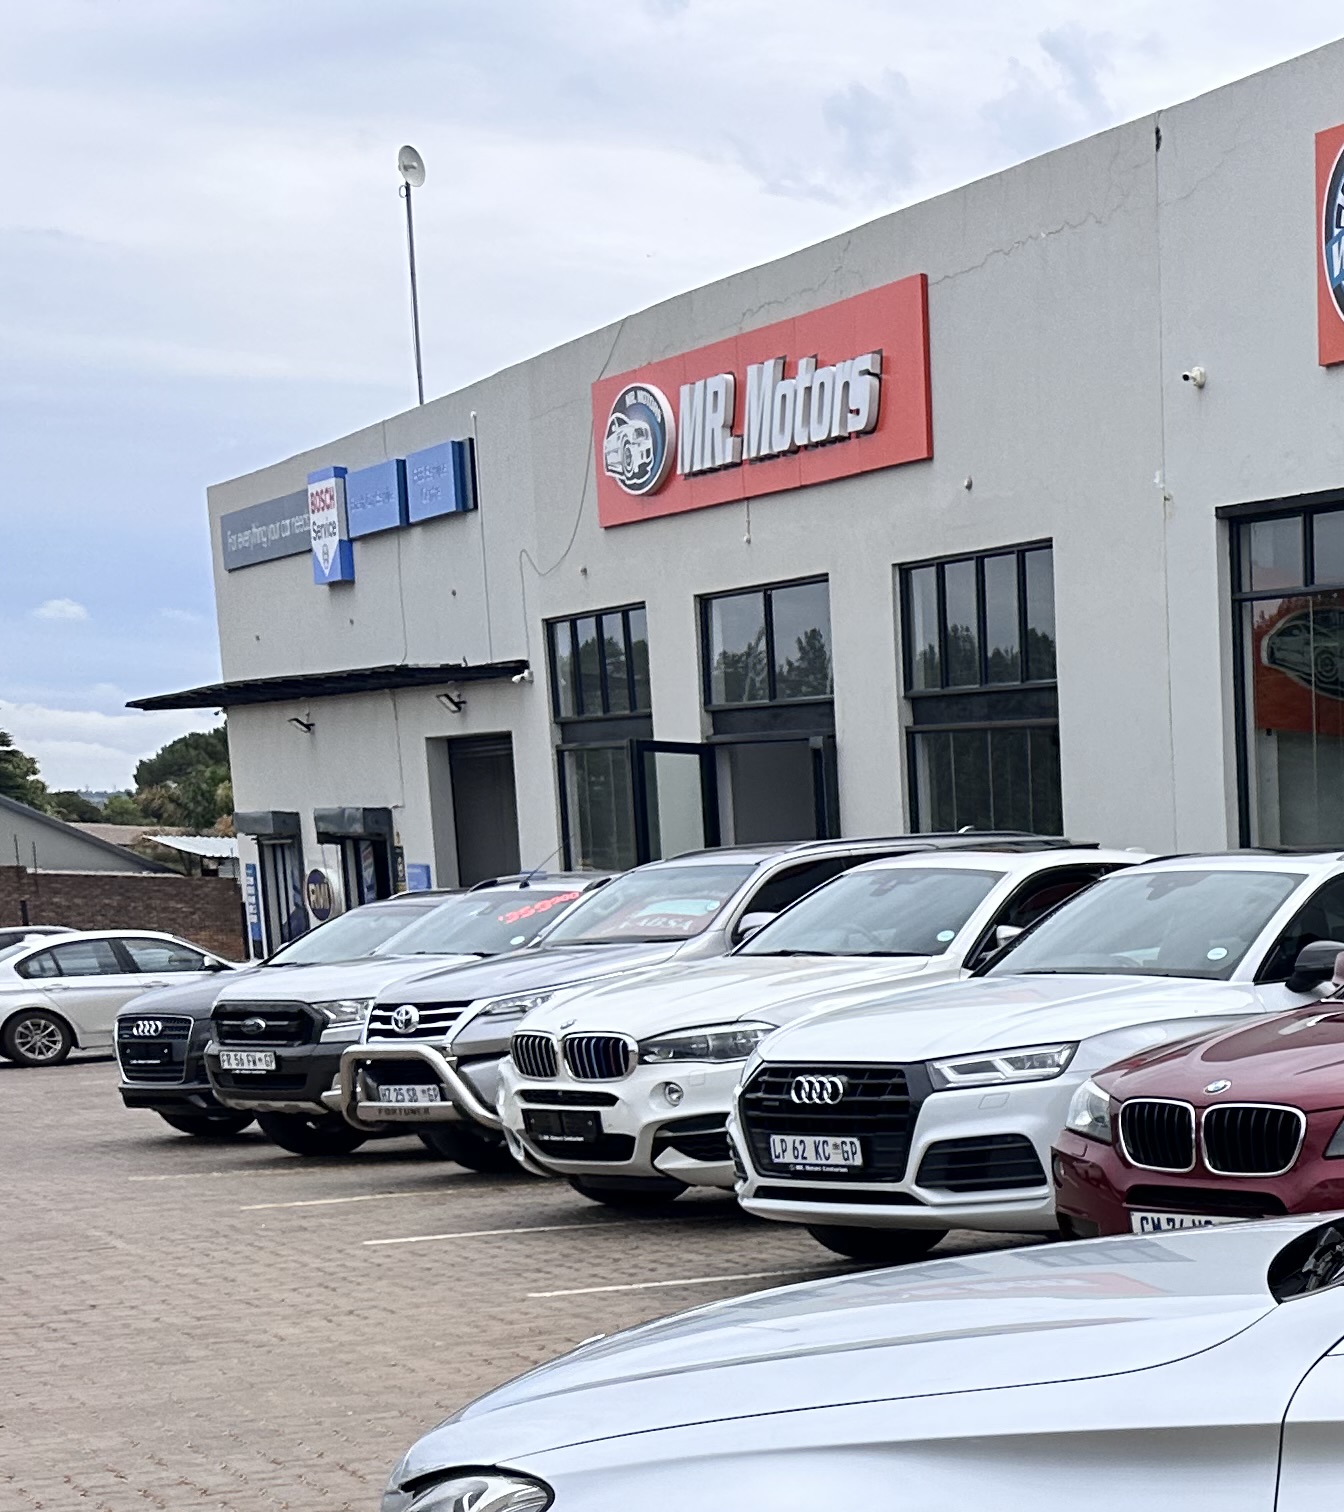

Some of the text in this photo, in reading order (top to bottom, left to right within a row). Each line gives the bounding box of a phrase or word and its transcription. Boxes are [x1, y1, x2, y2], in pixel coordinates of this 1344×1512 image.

[677, 352, 881, 475] MR. Motors
[310, 486, 336, 515] BOSCH
[312, 517, 337, 541] Service
[308, 883, 330, 909] RMI
[772, 1138, 858, 1162] LP 62 KC GP
